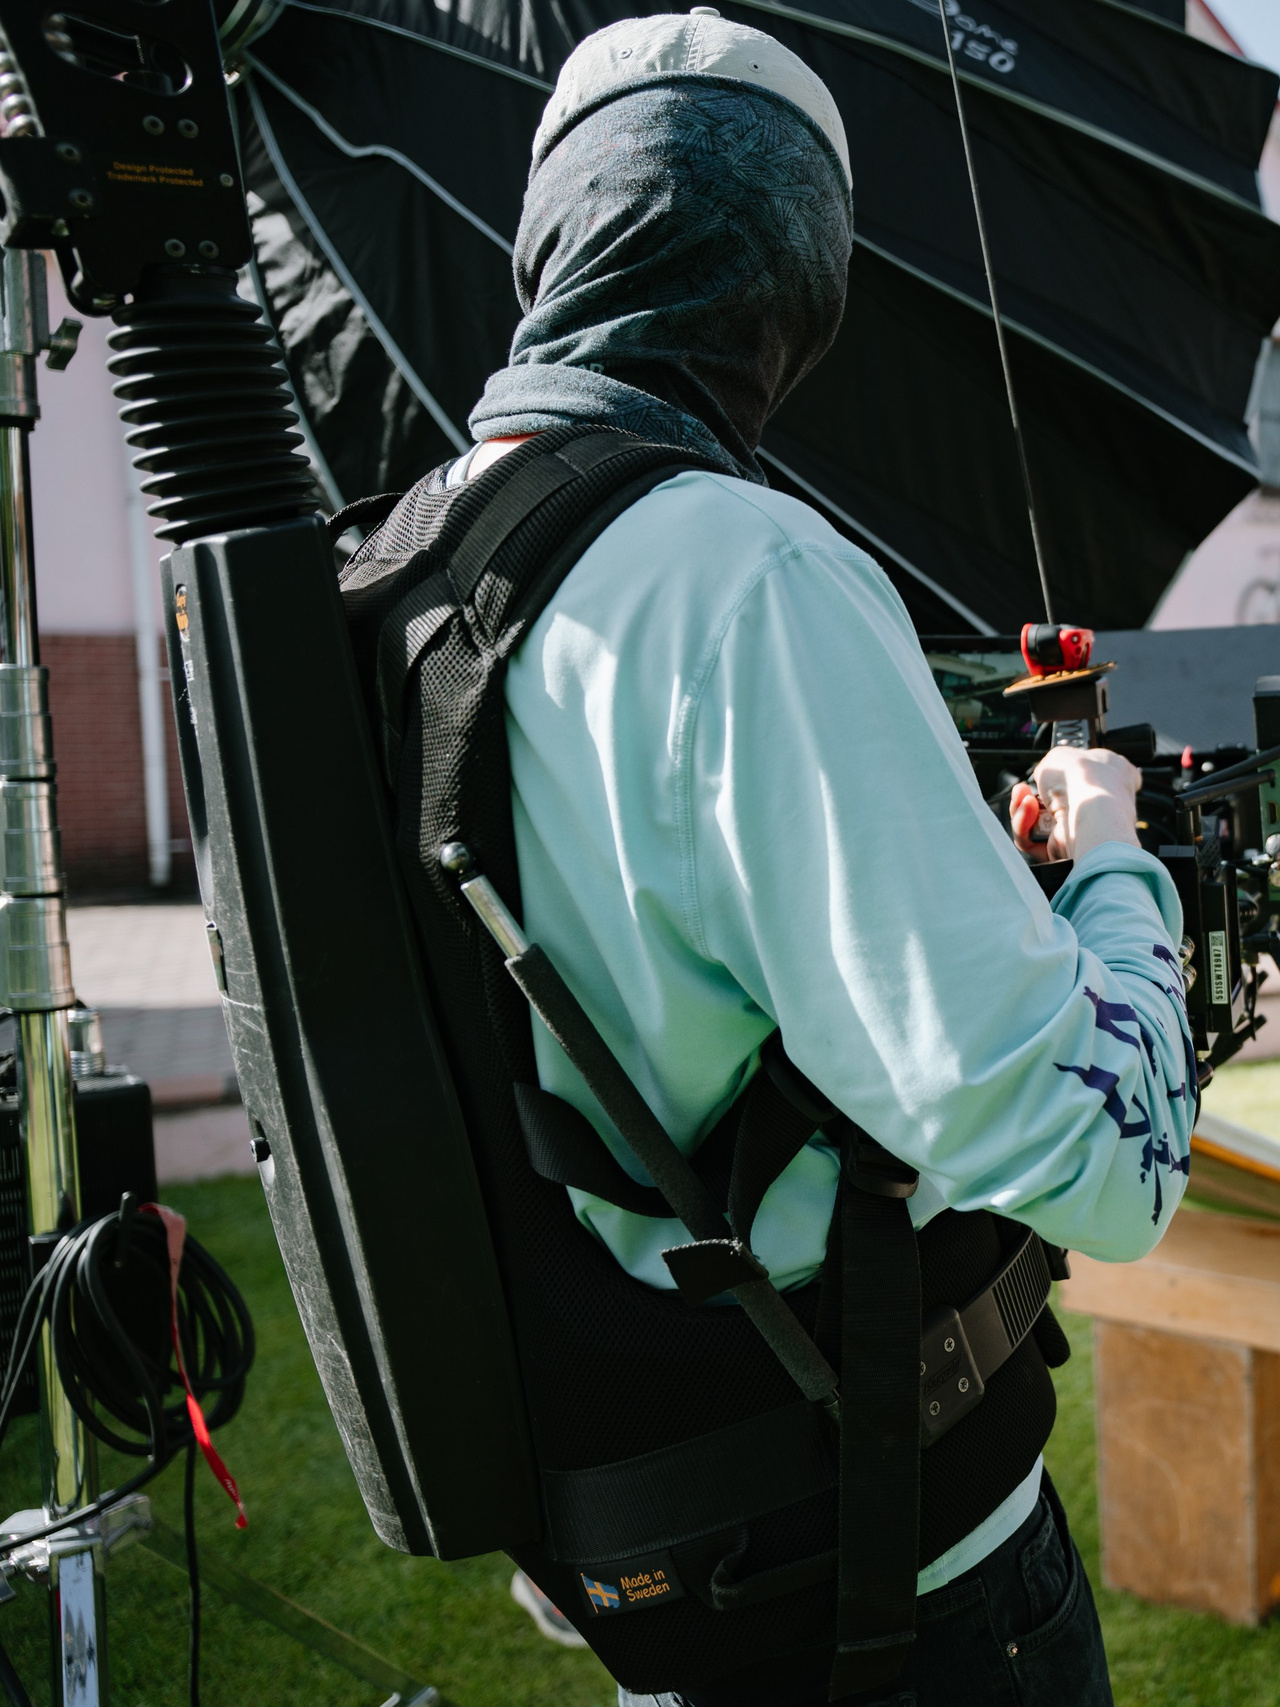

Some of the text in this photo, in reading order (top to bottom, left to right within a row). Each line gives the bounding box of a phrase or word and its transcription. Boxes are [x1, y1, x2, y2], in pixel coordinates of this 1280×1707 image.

[942, 0, 1018, 56] ome
[951, 30, 1015, 73] 150
[113, 161, 194, 176] Design Protected
[107, 171, 204, 187] Trademark Protected
[620, 1569, 666, 1590] Made in
[626, 1582, 671, 1602] Sweden
